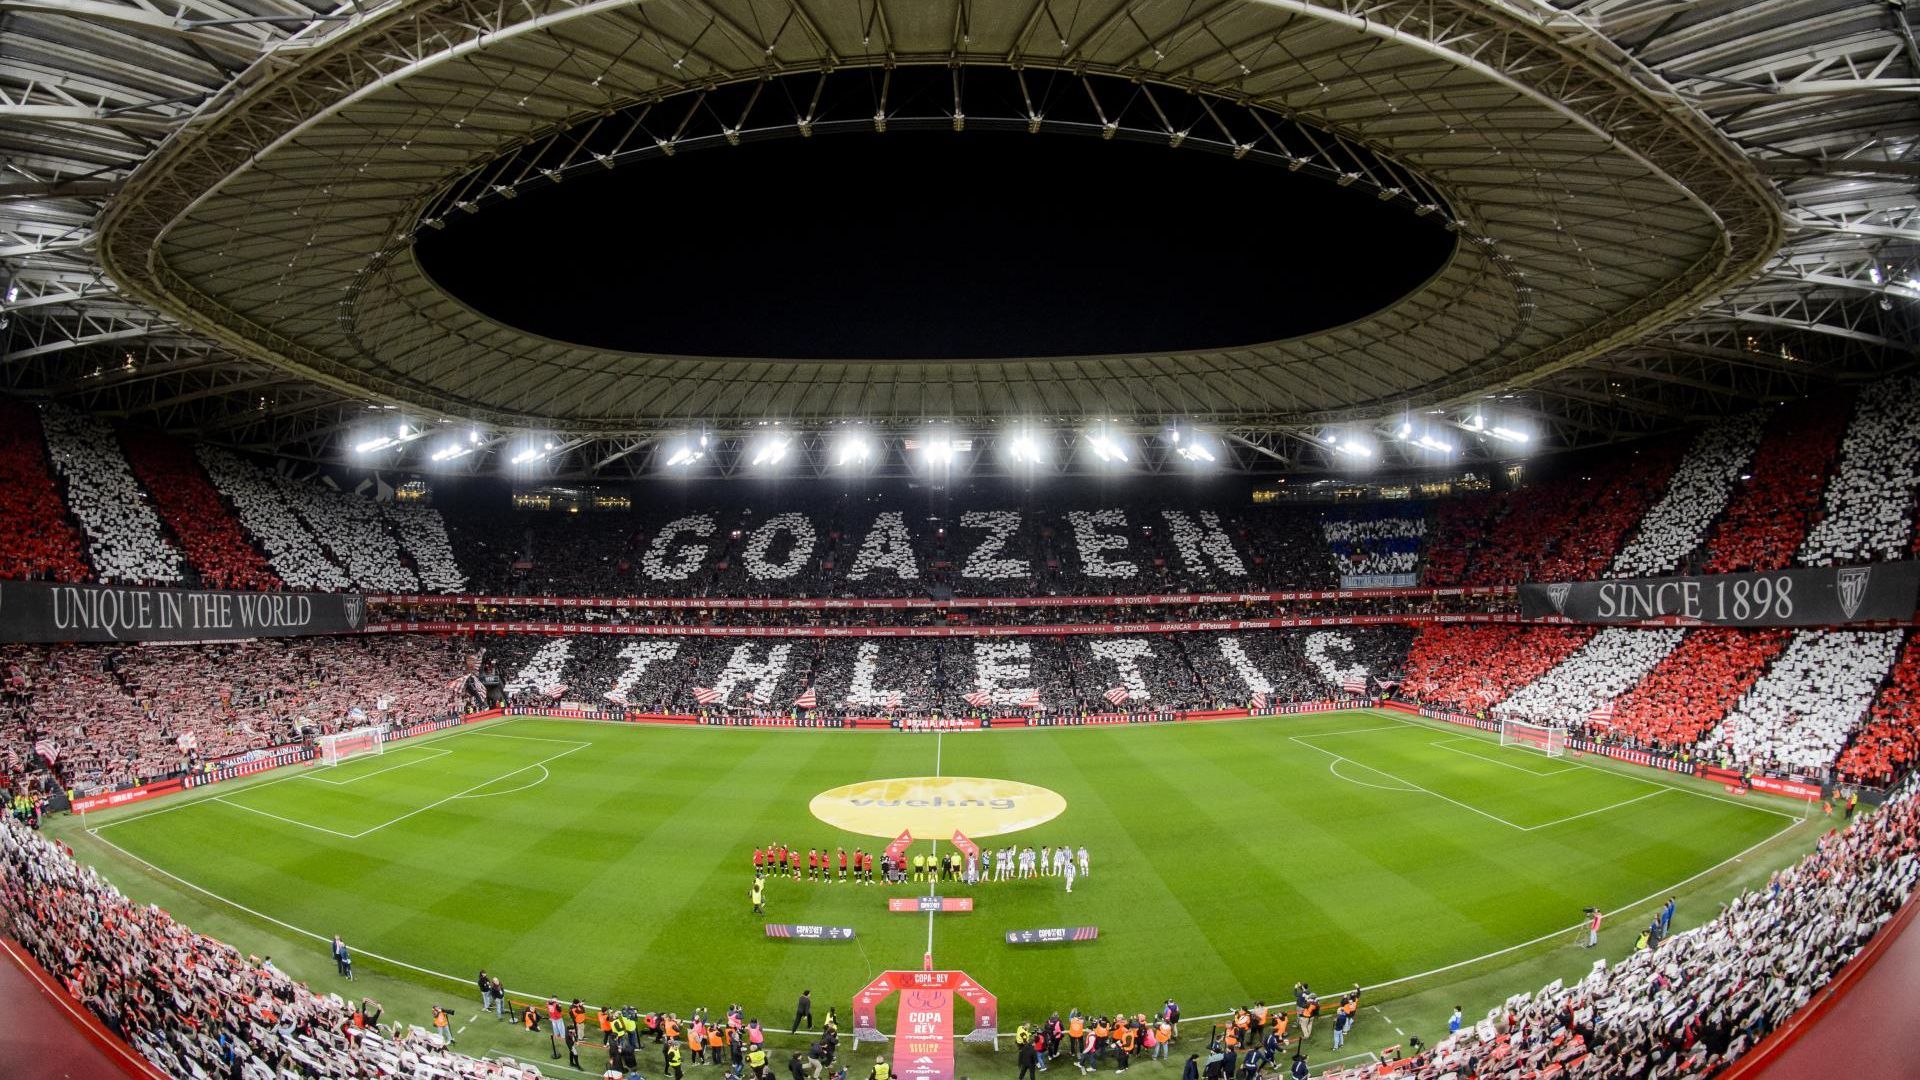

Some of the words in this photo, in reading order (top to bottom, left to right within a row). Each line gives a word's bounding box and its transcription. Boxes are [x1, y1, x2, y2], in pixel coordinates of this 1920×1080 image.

[641, 508, 1248, 581] GOAZEN
[51, 587, 152, 639] UNIQUE
[158, 591, 183, 629] IN
[189, 593, 233, 629] THE
[238, 594, 312, 628] WORLD
[1597, 581, 1701, 619] SINCE
[1715, 576, 1793, 621] 1898
[502, 631, 1369, 706] ATHLETIC
[850, 796, 1015, 809] vueling
[914, 974, 932, 983] COPA
[936, 974, 949, 983] REY
[909, 1012, 942, 1023] COPA
[914, 1025, 935, 1034] REY
